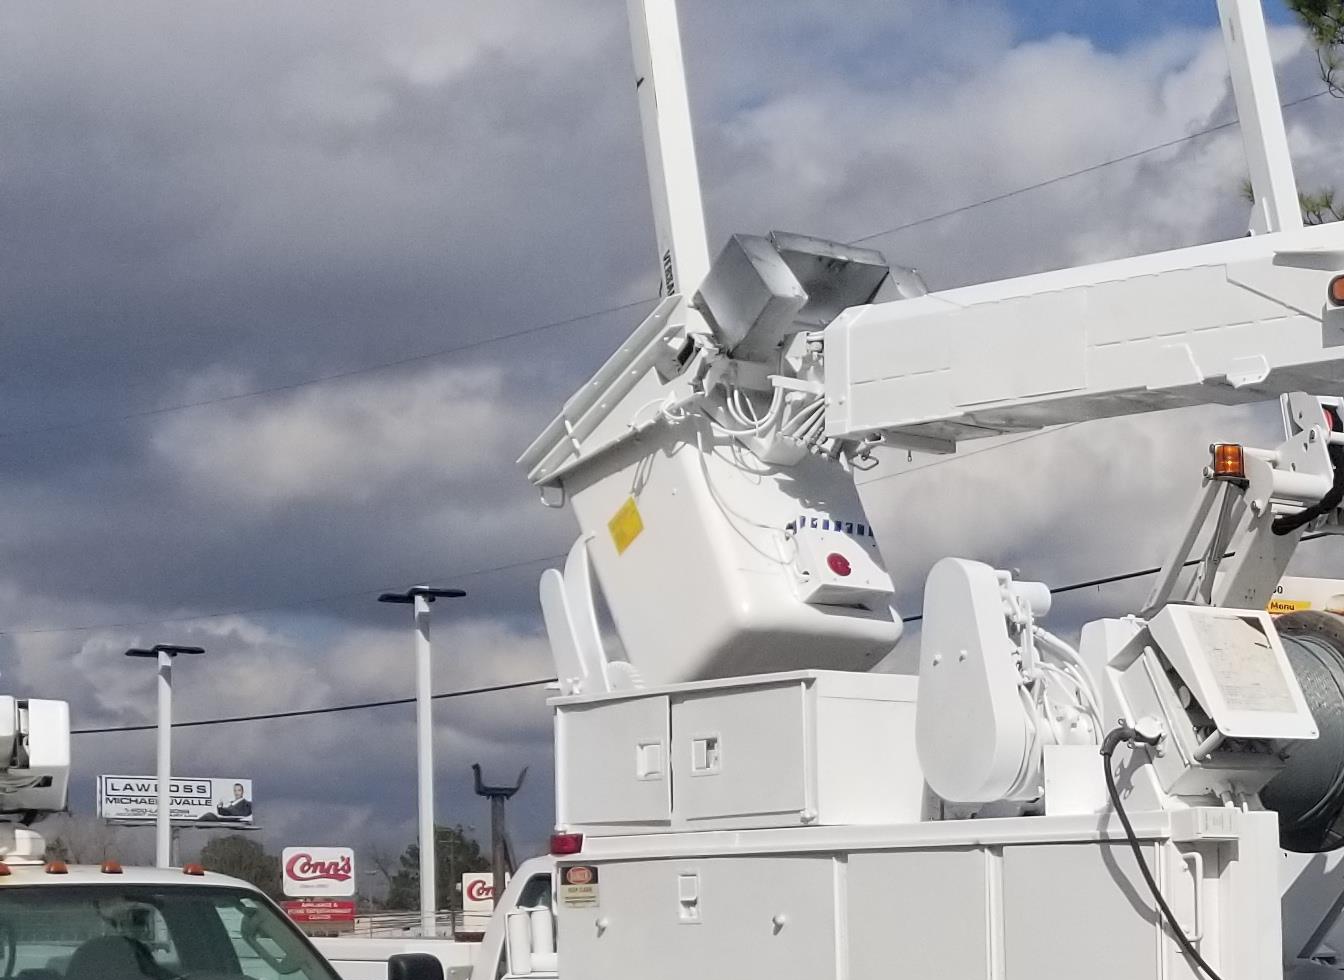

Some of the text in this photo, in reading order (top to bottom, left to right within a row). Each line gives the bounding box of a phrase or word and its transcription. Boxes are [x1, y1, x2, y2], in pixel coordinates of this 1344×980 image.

[111, 782, 207, 794] LAWOSS
[105, 797, 158, 805] MICHAE
[286, 853, 352, 882] Conn's
[466, 879, 496, 902] Con
